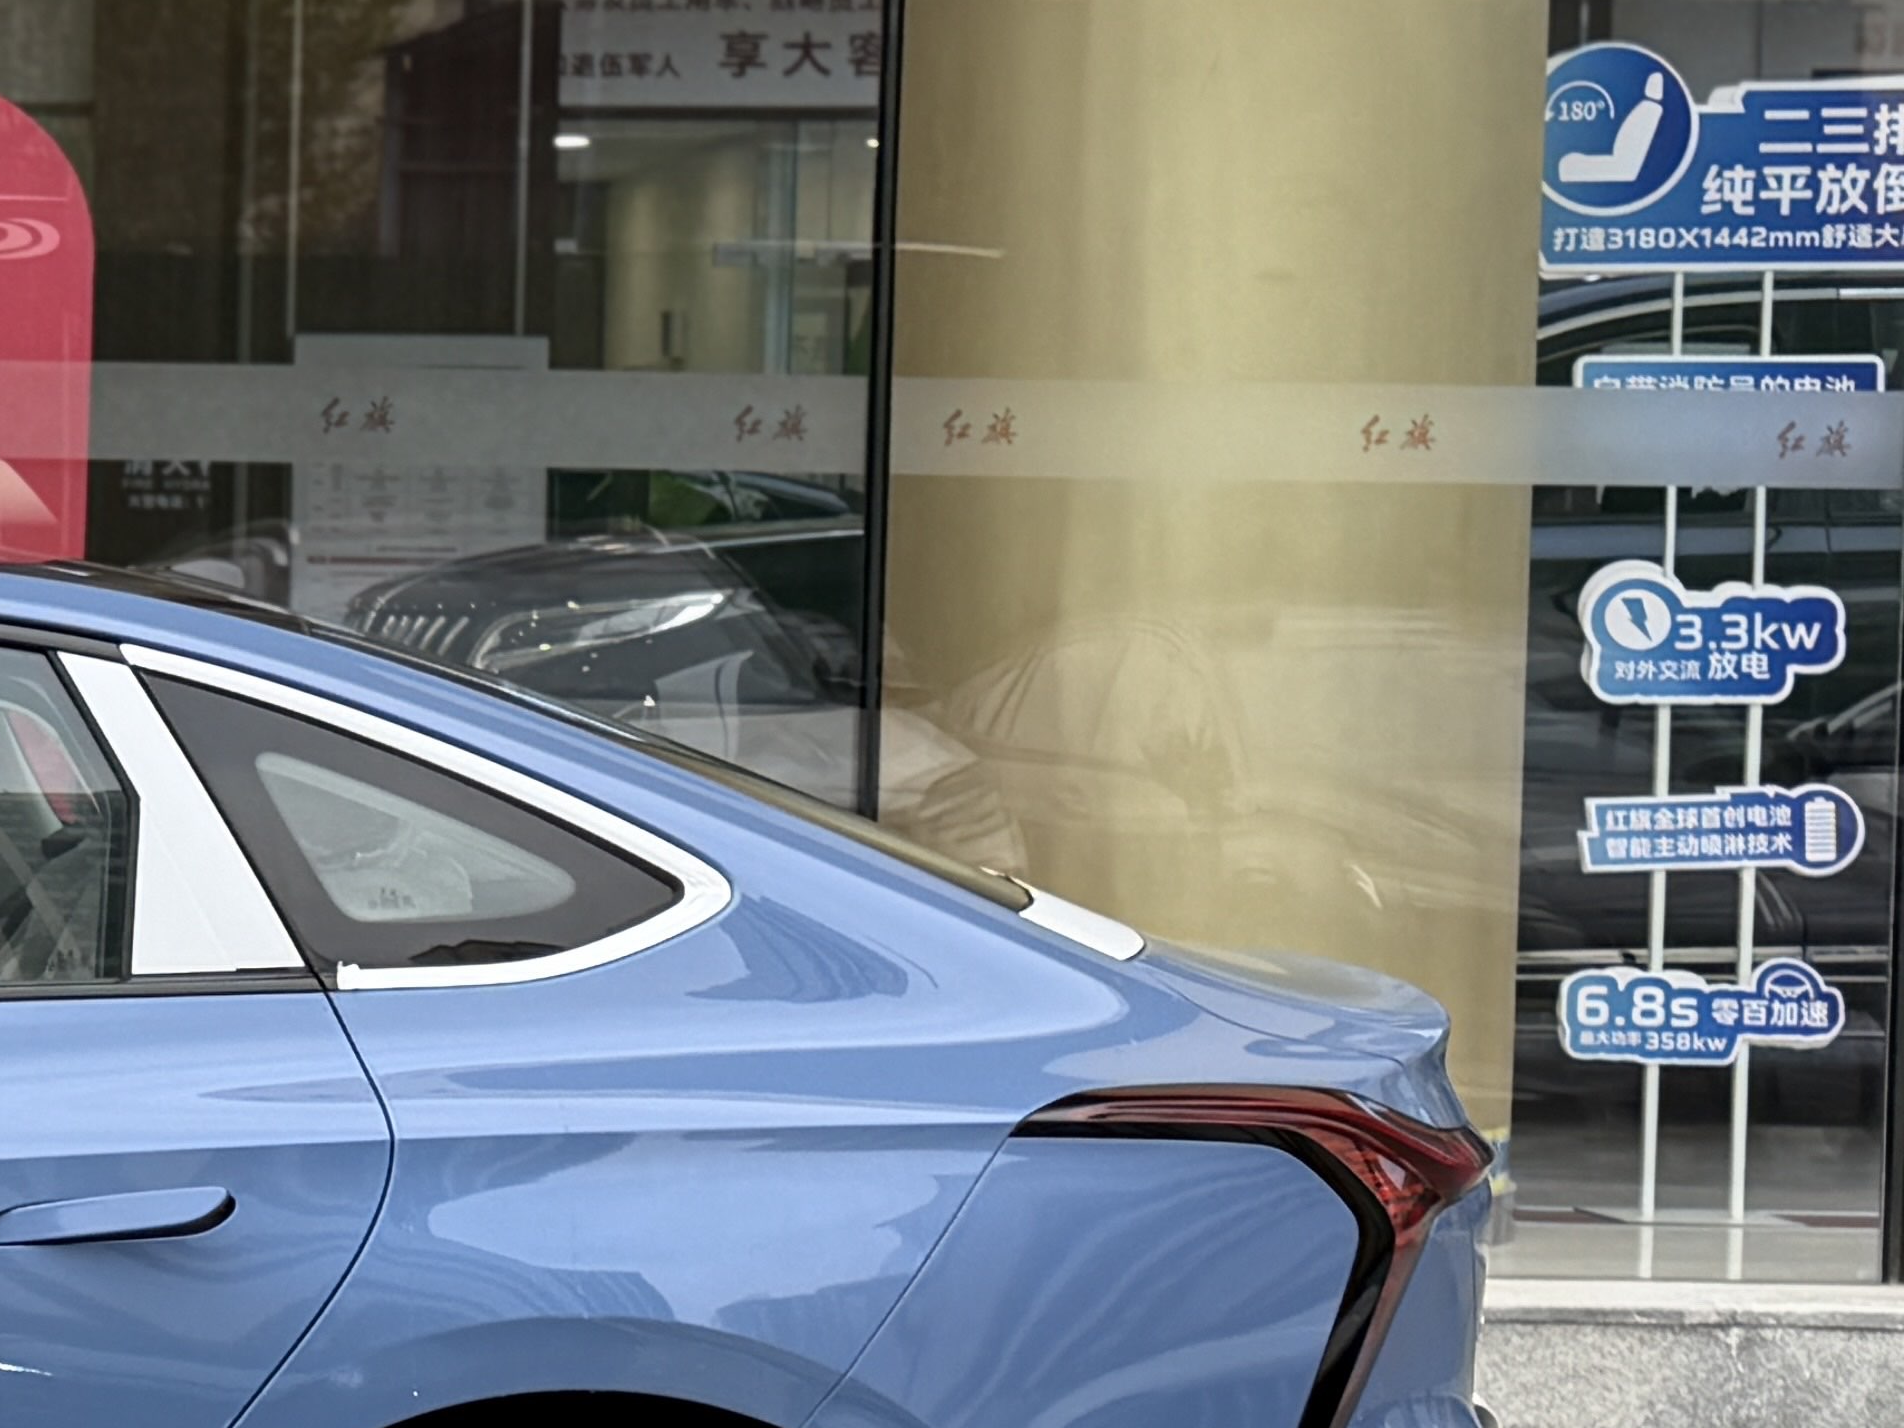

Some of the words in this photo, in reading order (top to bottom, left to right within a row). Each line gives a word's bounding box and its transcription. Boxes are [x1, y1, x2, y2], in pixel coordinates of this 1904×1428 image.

[1553, 225, 1904, 252] 打造3180X1442mm舒适大
[320, 396, 396, 435] 红旗
[734, 404, 808, 443] 红旗
[942, 408, 1020, 447] 红旗
[1360, 413, 1436, 452] 红旗
[1777, 420, 1852, 459] 红旗
[1673, 611, 1821, 650] 3.3kw
[1614, 659, 1701, 681] 对外交流
[1707, 652, 1771, 681] 放电
[1711, 997, 1830, 1028] 零百加速
[1644, 1033, 1728, 1052] 358kw
